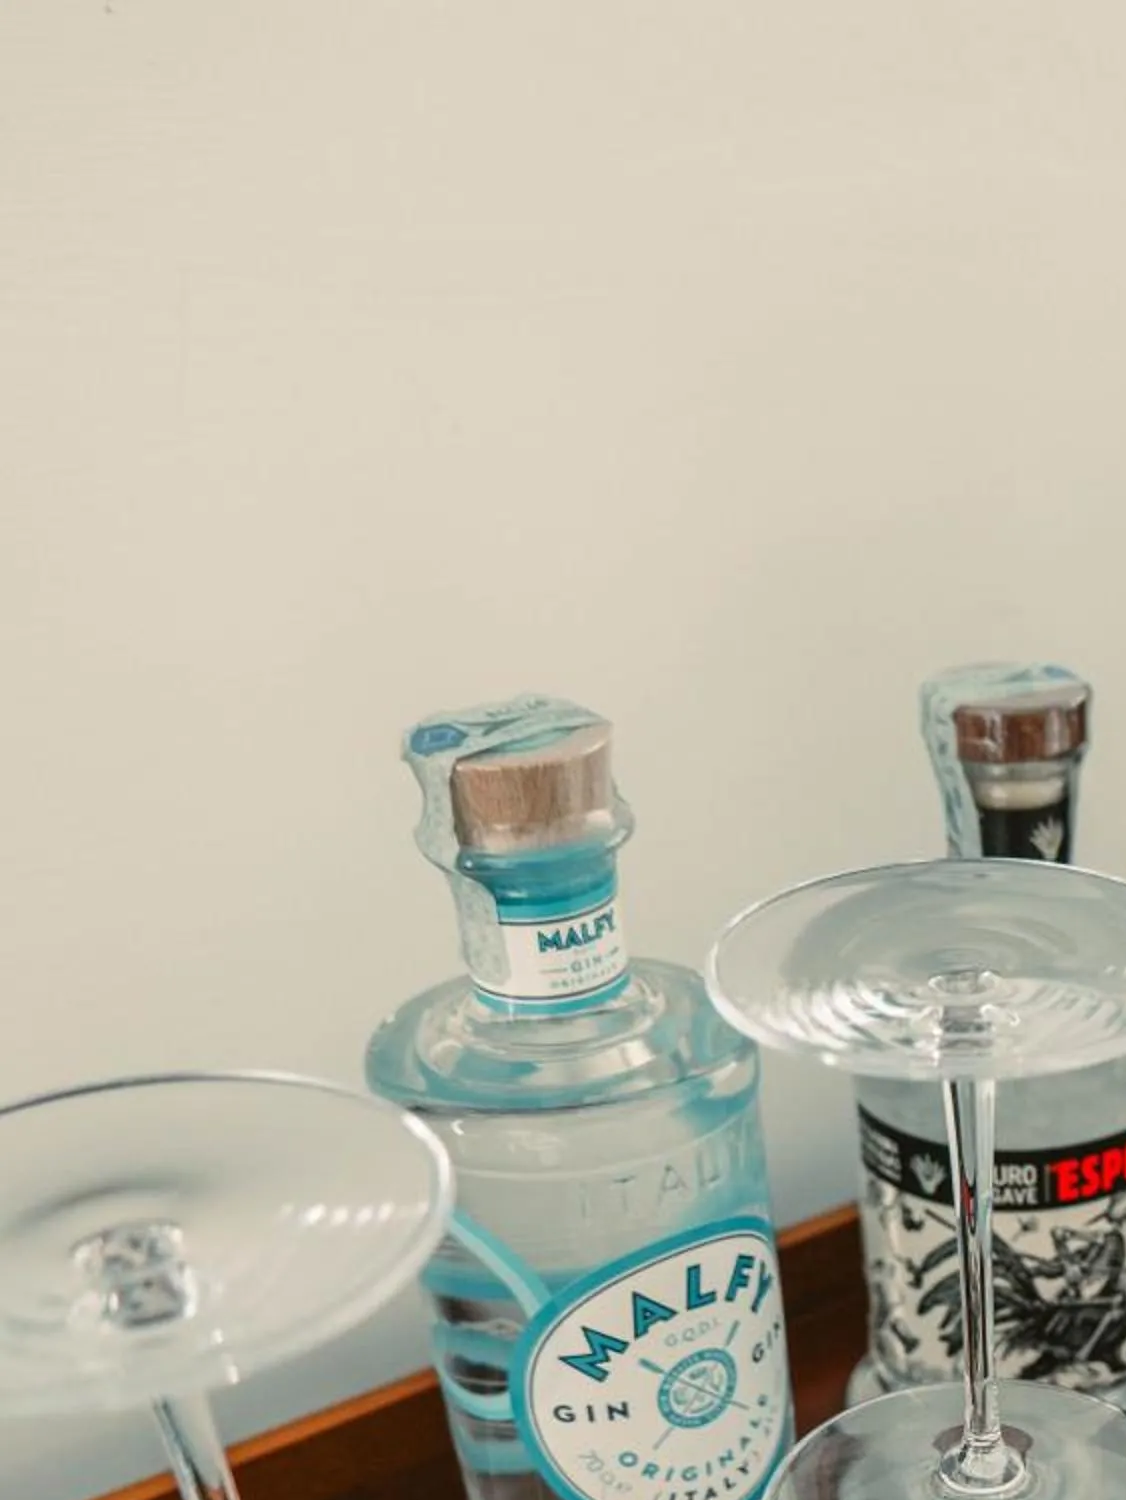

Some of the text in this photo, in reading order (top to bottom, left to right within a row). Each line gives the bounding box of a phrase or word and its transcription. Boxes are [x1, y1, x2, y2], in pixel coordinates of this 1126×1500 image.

[537, 907, 616, 953] MALFY
[992, 1163, 1038, 1188] URO
[557, 1253, 774, 1383] MALFY
[553, 1402, 630, 1423] GIN
